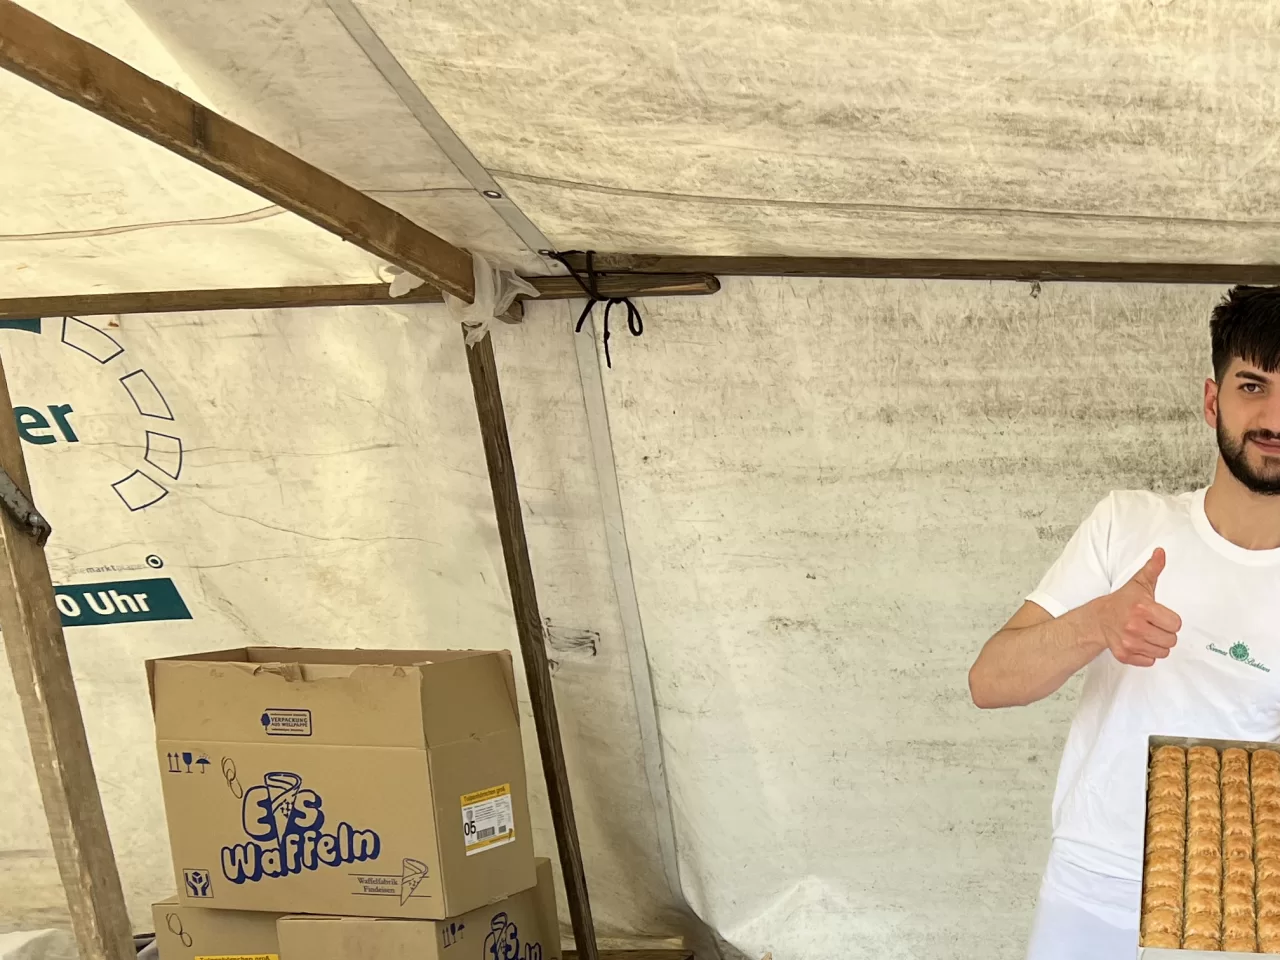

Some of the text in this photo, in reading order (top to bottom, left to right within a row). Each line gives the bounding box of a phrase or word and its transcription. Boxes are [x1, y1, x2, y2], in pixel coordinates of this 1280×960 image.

[83, 590, 150, 615] Uhr
[464, 820, 477, 836] 05
[221, 822, 381, 884] Waffeln
[357, 877, 398, 886] Waffelfabrik
